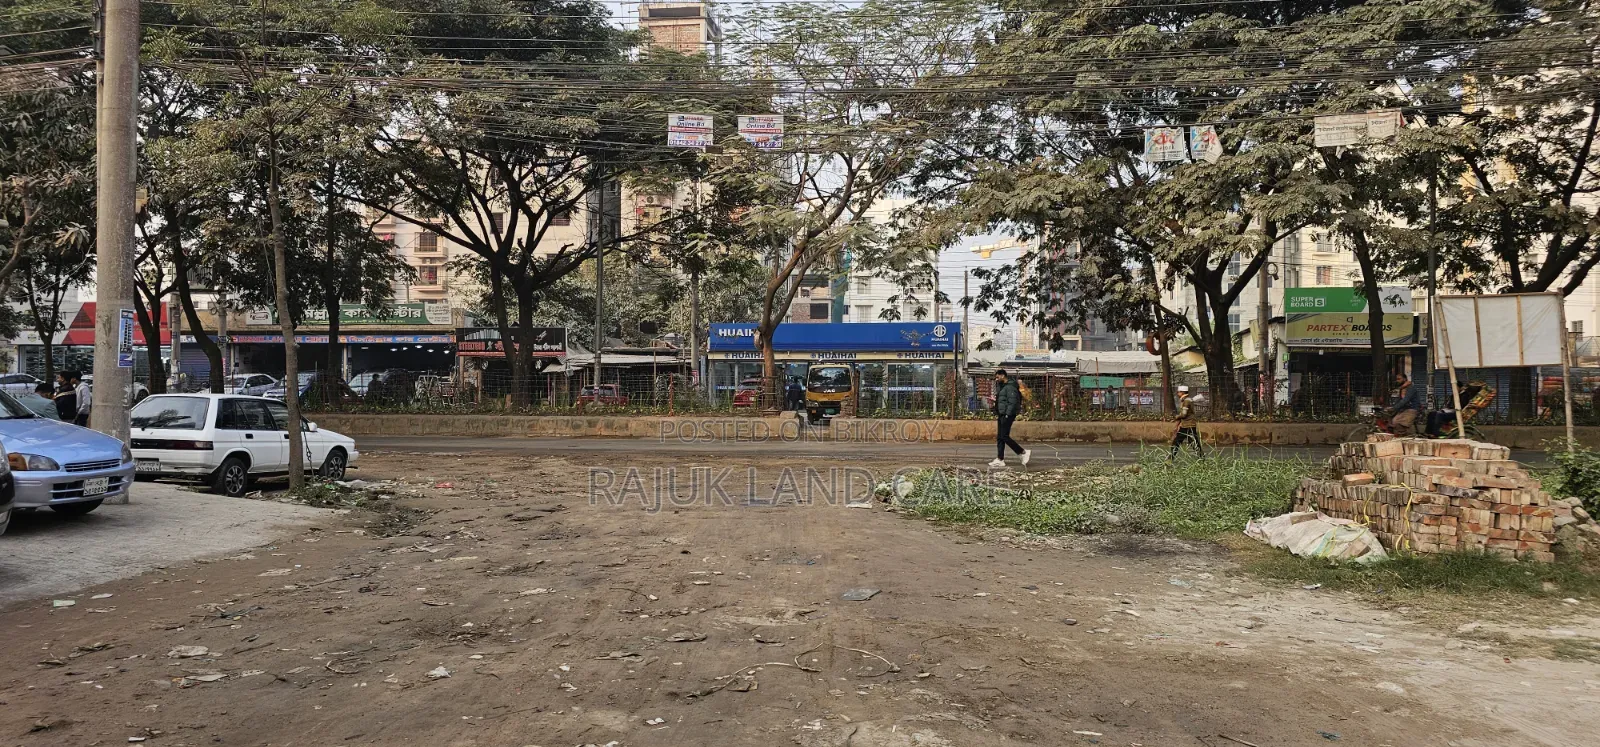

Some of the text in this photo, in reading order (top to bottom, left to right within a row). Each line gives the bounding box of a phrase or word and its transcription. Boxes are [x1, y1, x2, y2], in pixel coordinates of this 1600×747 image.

[1306, 324, 1393, 332] PARTEX BOADS
[718, 328, 756, 337] HUAIH
